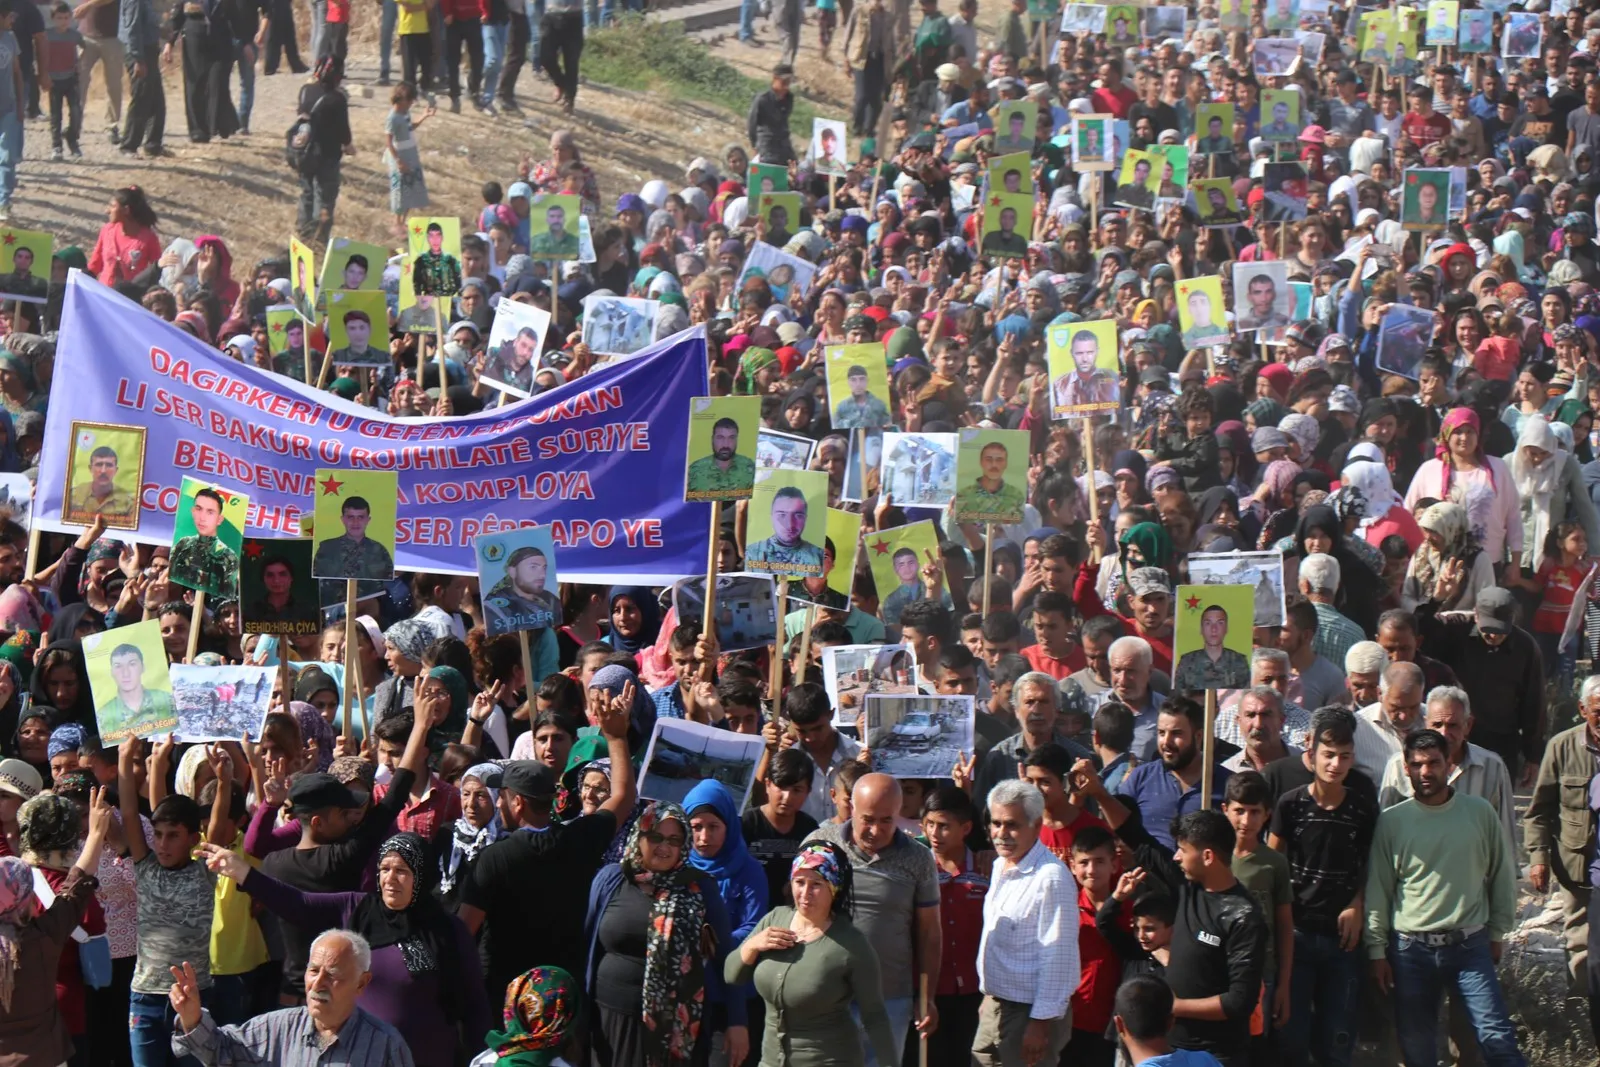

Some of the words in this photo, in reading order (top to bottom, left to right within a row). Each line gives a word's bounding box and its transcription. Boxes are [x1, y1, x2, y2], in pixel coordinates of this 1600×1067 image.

[116, 377, 148, 411] LI
[153, 388, 205, 430] SER
[209, 409, 314, 460] BAKUR
[318, 438, 344, 465] Û
[350, 437, 532, 471] ROJHILATÊ
[538, 421, 650, 460] SÛRIYE
[415, 471, 595, 504] KOMPLOYA
[395, 516, 454, 546] SER
[551, 519, 616, 548] APO
[621, 518, 664, 548] YE
